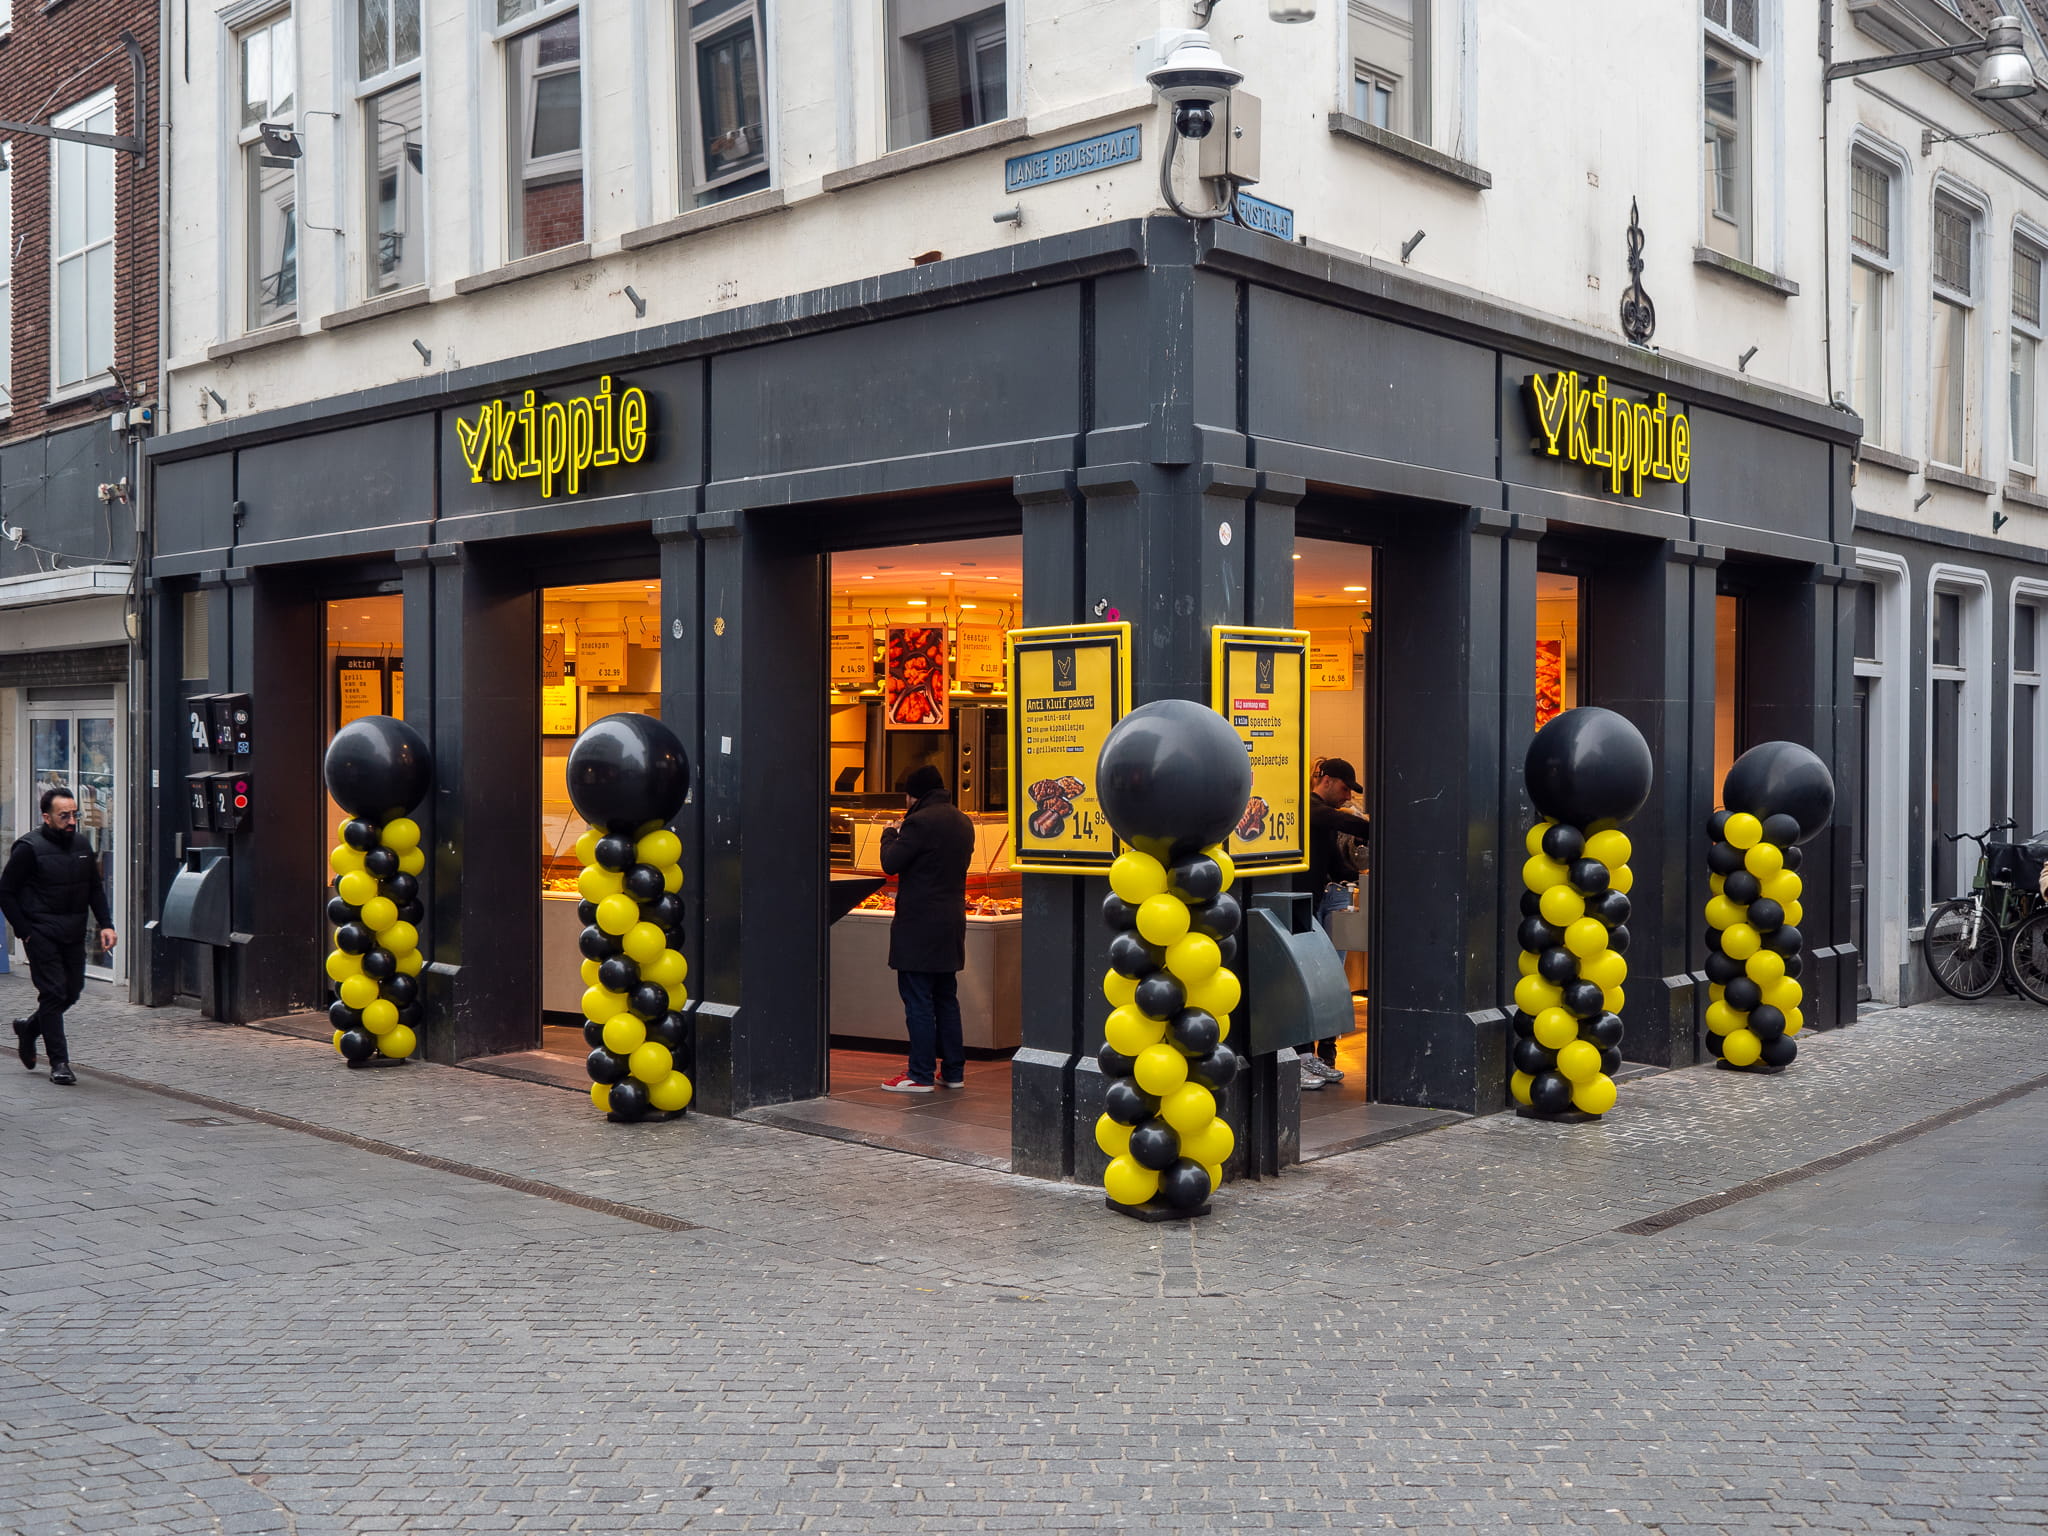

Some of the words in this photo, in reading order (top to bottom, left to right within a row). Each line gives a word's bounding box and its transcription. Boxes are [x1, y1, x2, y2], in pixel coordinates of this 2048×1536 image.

[1009, 156, 1049, 186] LANGE
[1054, 134, 1134, 174] BRUGSTRAAT
[1228, 199, 1290, 236] ENSTRAAT
[493, 375, 647, 498] kippie
[1569, 371, 1690, 498] kippie
[348, 660, 375, 669] aktie!
[1027, 699, 1044, 711] Anti
[1046, 697, 1067, 710] kluif
[1068, 697, 1094, 709] pakket
[1250, 716, 1281, 728] spareribs
[191, 712, 209, 748] 2A
[1248, 754, 1288, 767] ppelpartjes
